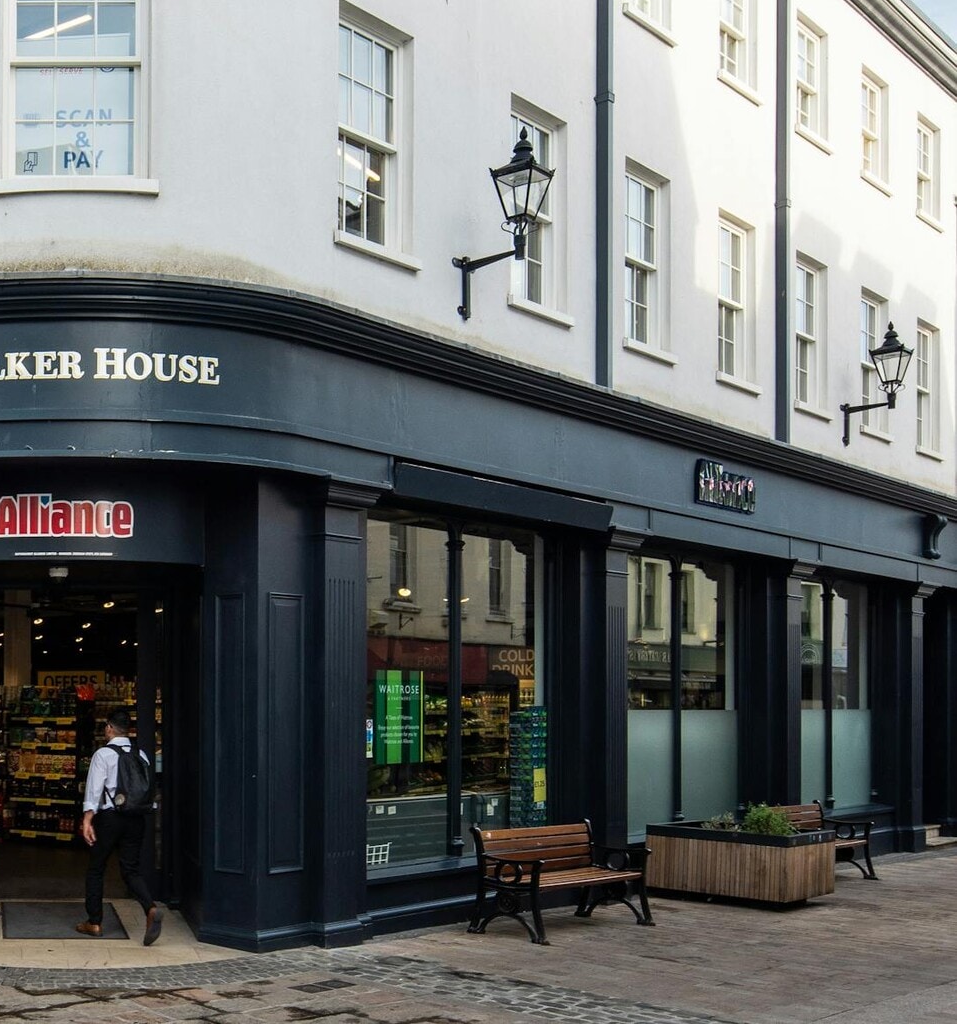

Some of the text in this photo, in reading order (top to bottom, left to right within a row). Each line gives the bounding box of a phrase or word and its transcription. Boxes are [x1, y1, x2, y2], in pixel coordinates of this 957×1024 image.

[56, 108, 112, 129] SCAN
[75, 131, 91, 148] &
[63, 150, 104, 169] PAY
[92, 347, 221, 386] HOUSE
[498, 649, 535, 662] COLD
[378, 684, 420, 694] WAITROSE
